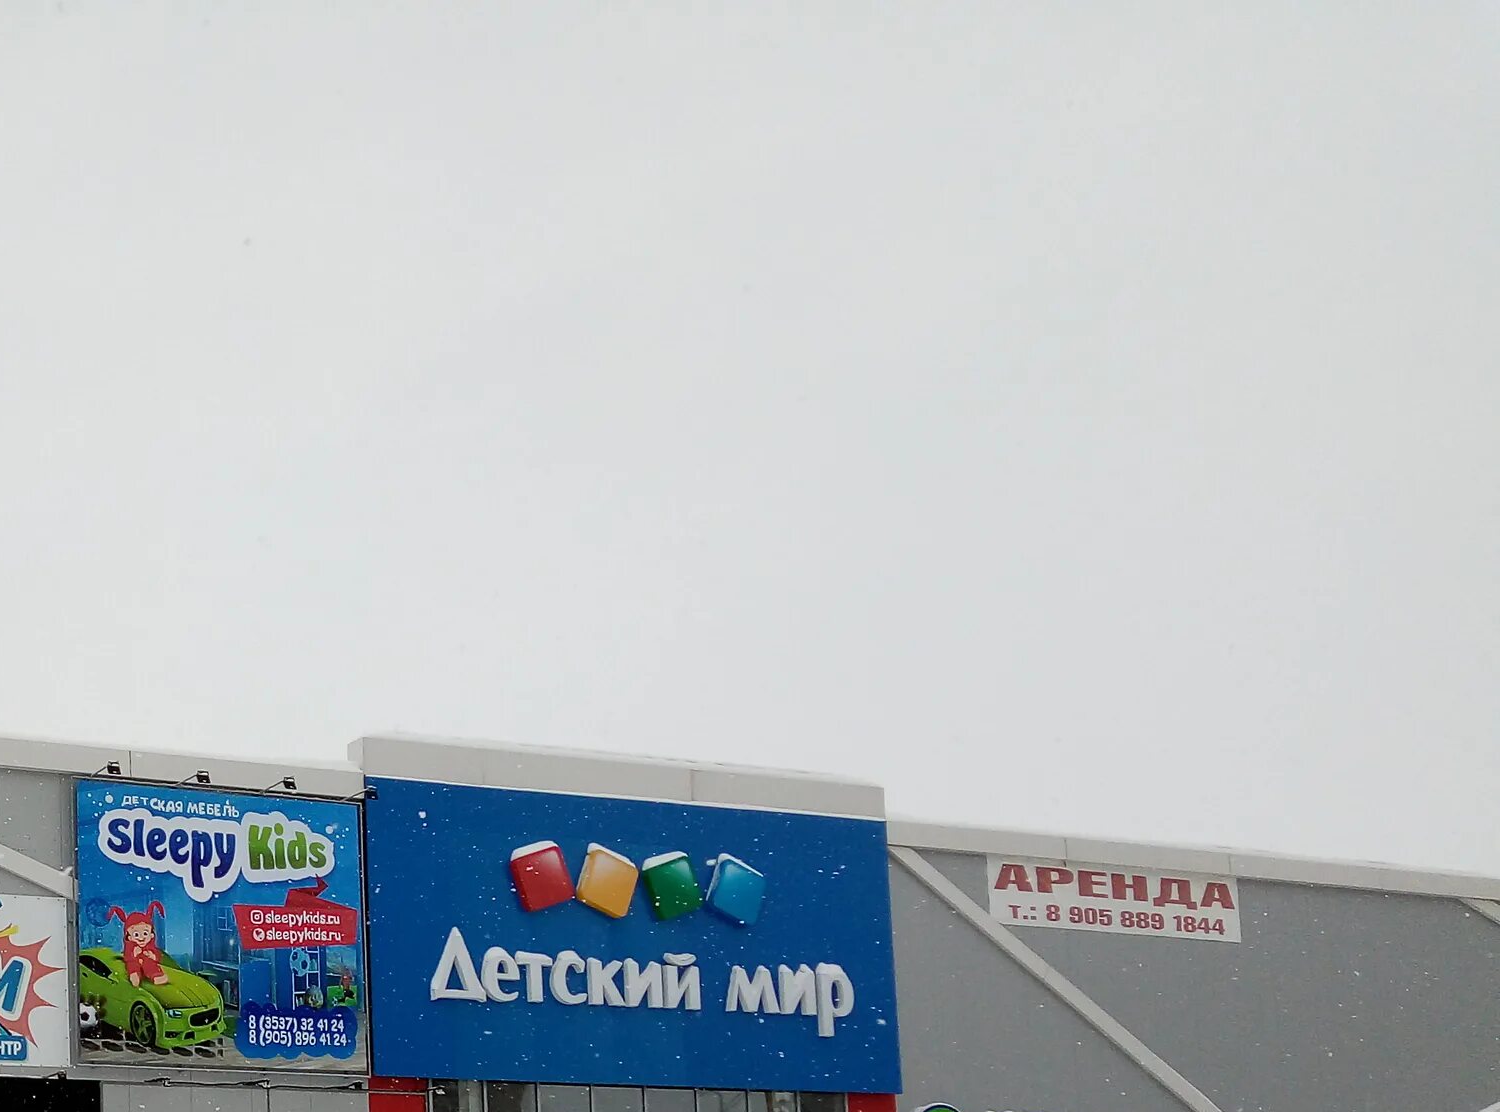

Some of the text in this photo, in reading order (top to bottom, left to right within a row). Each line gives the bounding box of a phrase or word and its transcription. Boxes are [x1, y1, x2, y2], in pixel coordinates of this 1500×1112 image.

[121, 795, 240, 818] ДЕТСКАЯ МЕБЕЛЬ
[107, 818, 327, 887] Sleepy Kids
[994, 863, 1235, 910] АРЕНДА
[1046, 904, 1061, 922] 8
[1069, 906, 1113, 926] 905
[1120, 911, 1165, 930] 889
[1172, 915, 1226, 936] 1844
[431, 926, 854, 1037] Детский мир
[249, 1015, 344, 1033] 8 (3537) 32 41 24
[249, 1030, 347, 1047] 8 (905) 896 41 24
